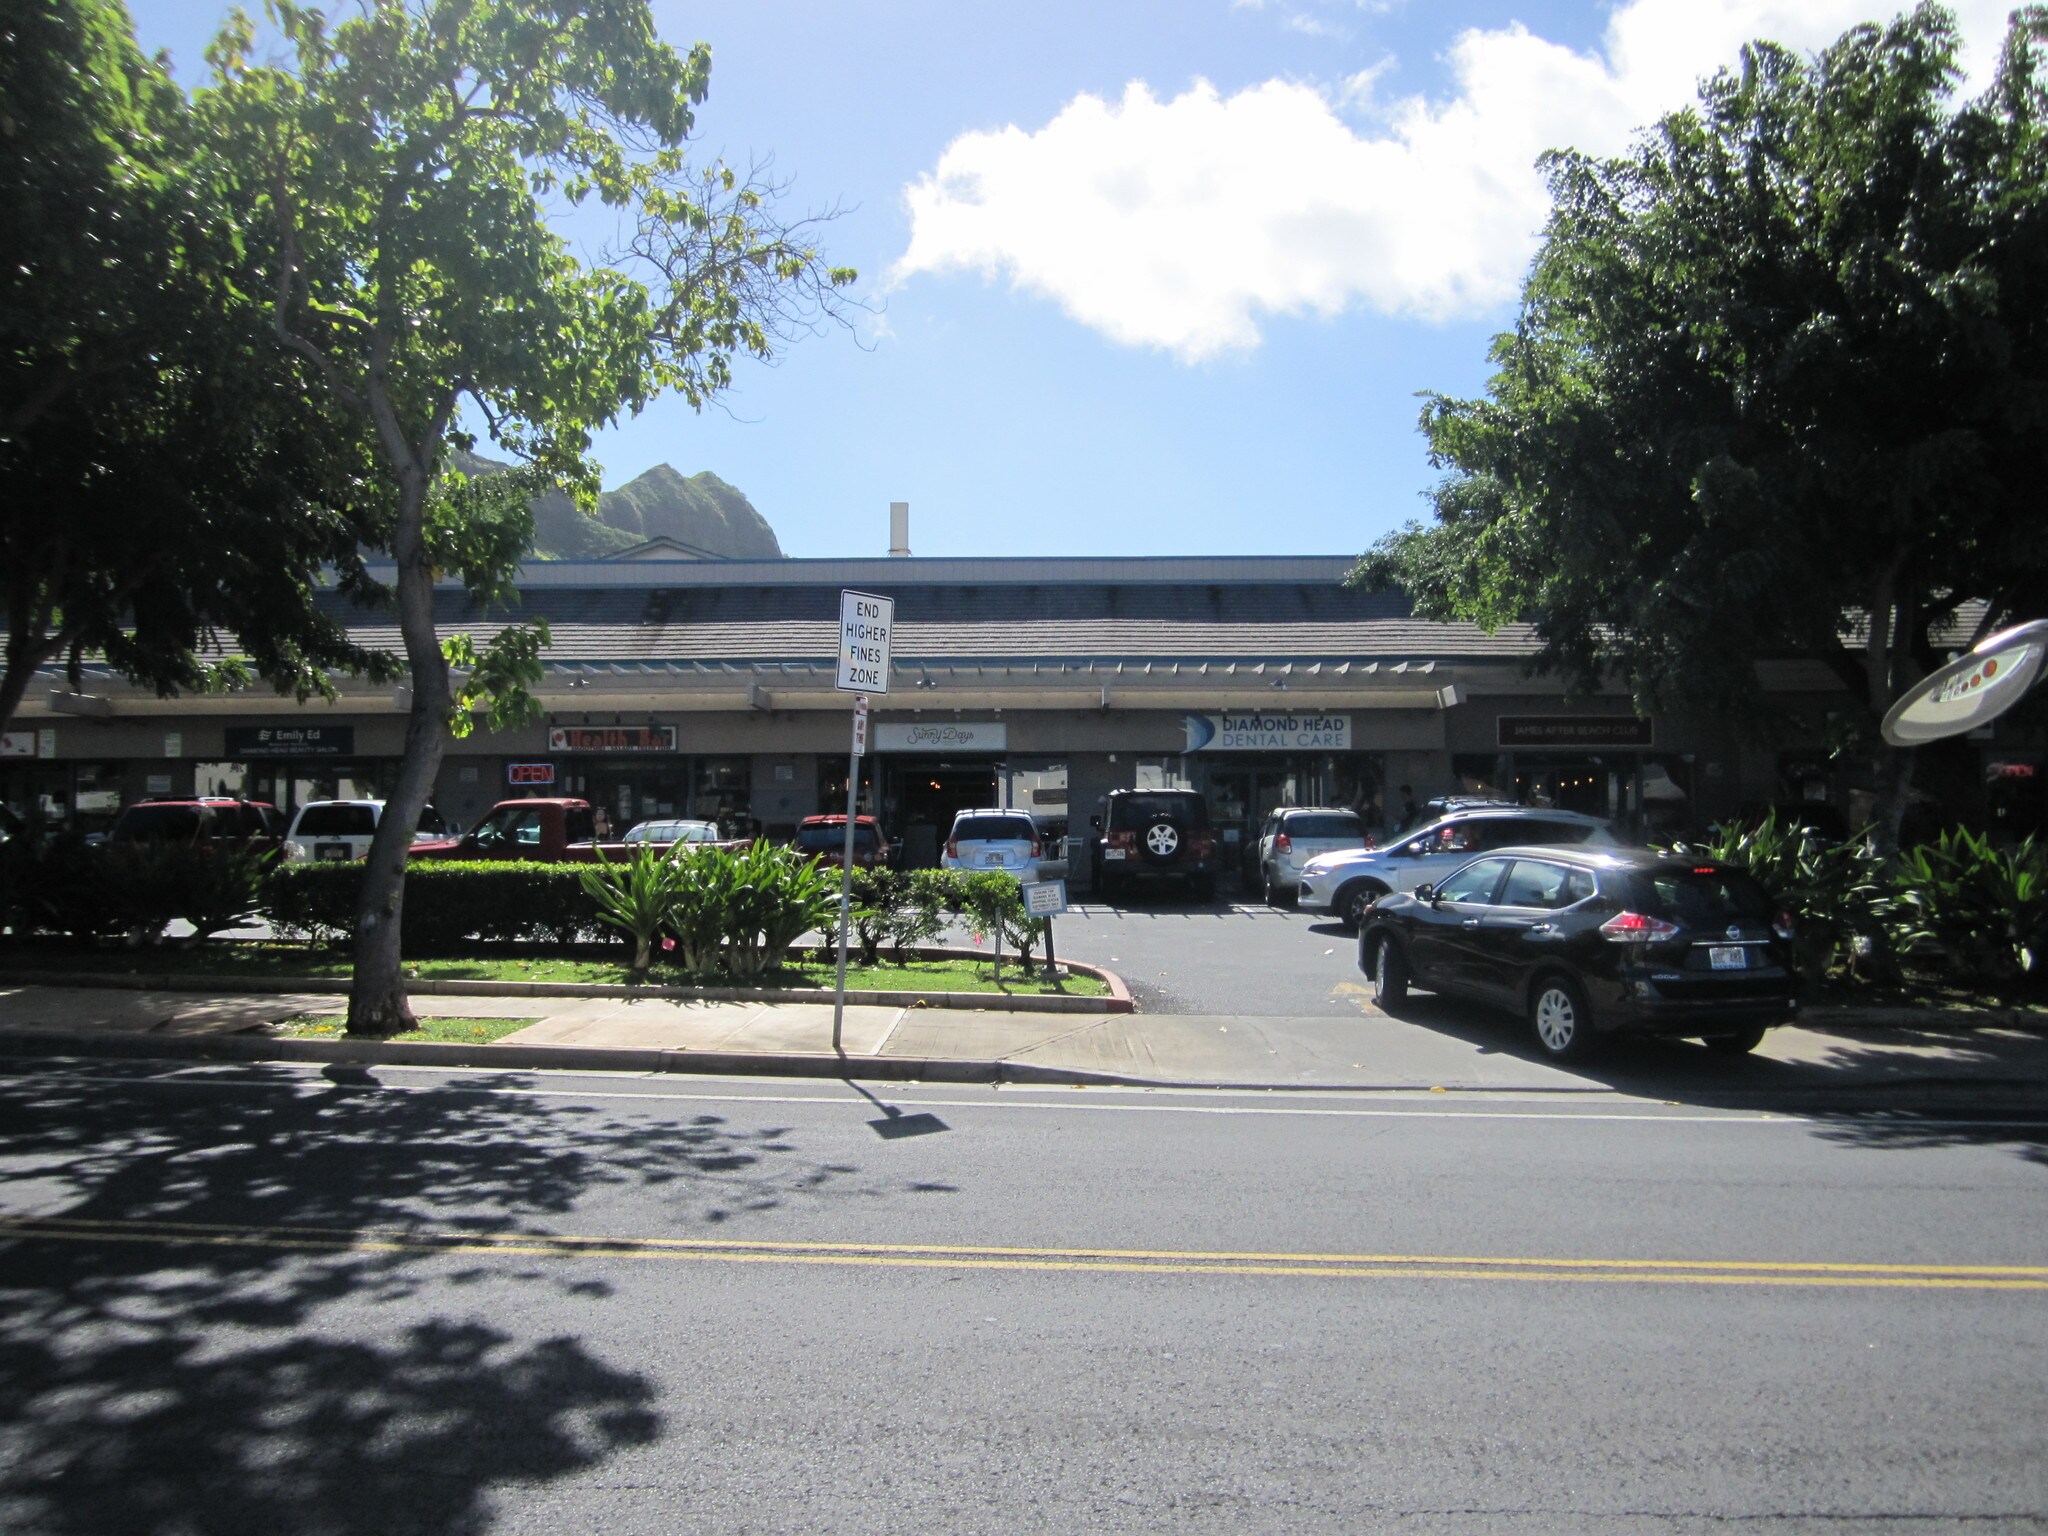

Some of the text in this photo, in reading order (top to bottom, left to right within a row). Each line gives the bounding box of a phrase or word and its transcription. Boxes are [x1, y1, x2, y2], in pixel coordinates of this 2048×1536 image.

[856, 602, 879, 619] END
[846, 622, 887, 642] HIGHER
[850, 645, 881, 663] FINES
[849, 667, 879, 685] ZONE
[1223, 719, 1344, 732] DIAMOND HEAD
[1514, 726, 1543, 735] JAMES
[276, 729, 320, 742] Emily Ed
[571, 729, 671, 746] Health Bar
[907, 727, 974, 744] Sunny Days
[1223, 733, 1344, 747] DENTAL CARE
[511, 766, 553, 782] OPEN
